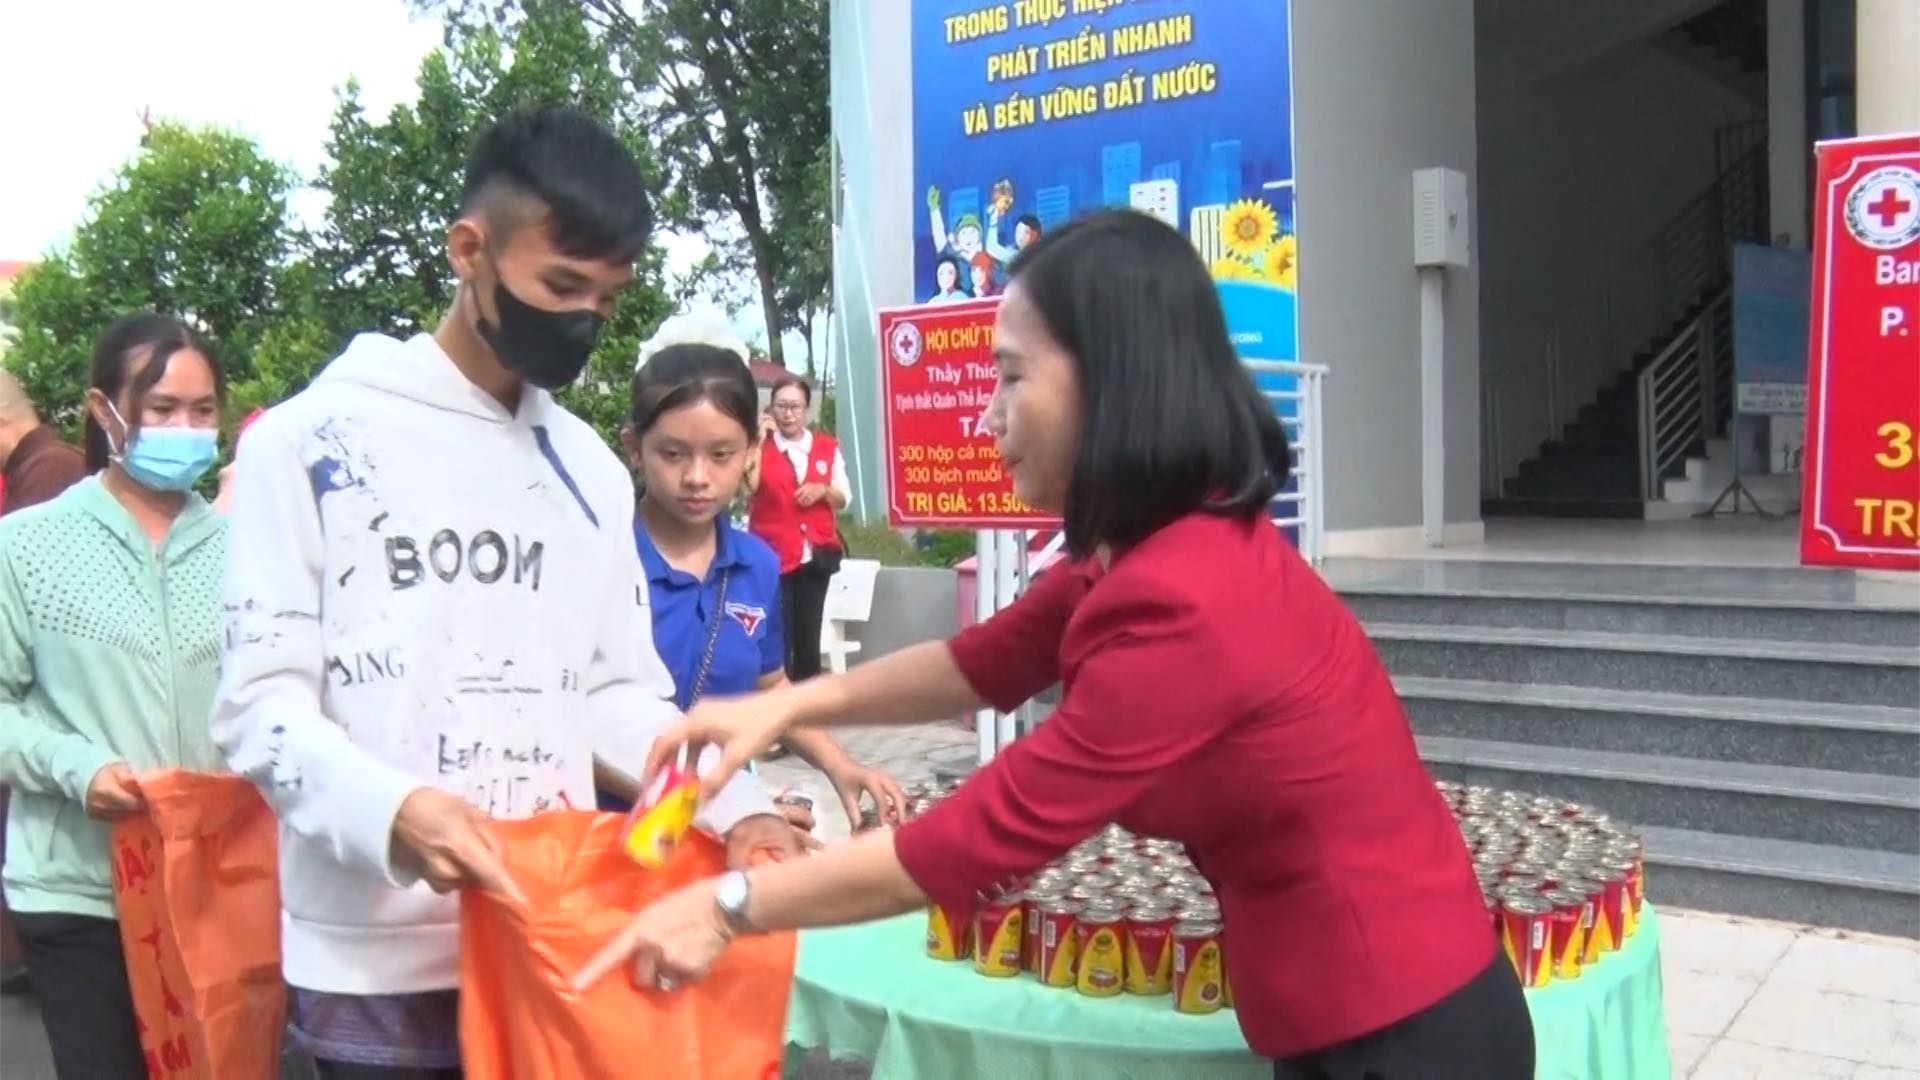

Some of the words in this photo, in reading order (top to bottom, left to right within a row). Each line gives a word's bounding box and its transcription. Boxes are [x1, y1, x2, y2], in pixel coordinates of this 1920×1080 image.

[944, 6, 1008, 43] TRONG
[987, 43, 1039, 82] PHÁT
[1044, 24, 1106, 70] TRIỂN
[1112, 15, 1192, 56] NHANH
[963, 102, 989, 136] VÀ
[1040, 85, 1097, 121] VỮNG
[1103, 67, 1146, 110] ĐẤT
[1152, 60, 1216, 101] NƯỚC
[925, 328, 949, 355] HỘI
[950, 322, 981, 350] CHỮ
[1880, 306, 1908, 337] P.
[899, 445, 924, 462] 300
[927, 445, 953, 464] hộp
[957, 443, 975, 460] cá
[1875, 421, 1920, 469] 3
[904, 467, 930, 484] 300
[905, 491, 933, 516] TRỊ
[937, 488, 973, 513] GIÁ:
[384, 528, 544, 592] BOOM
